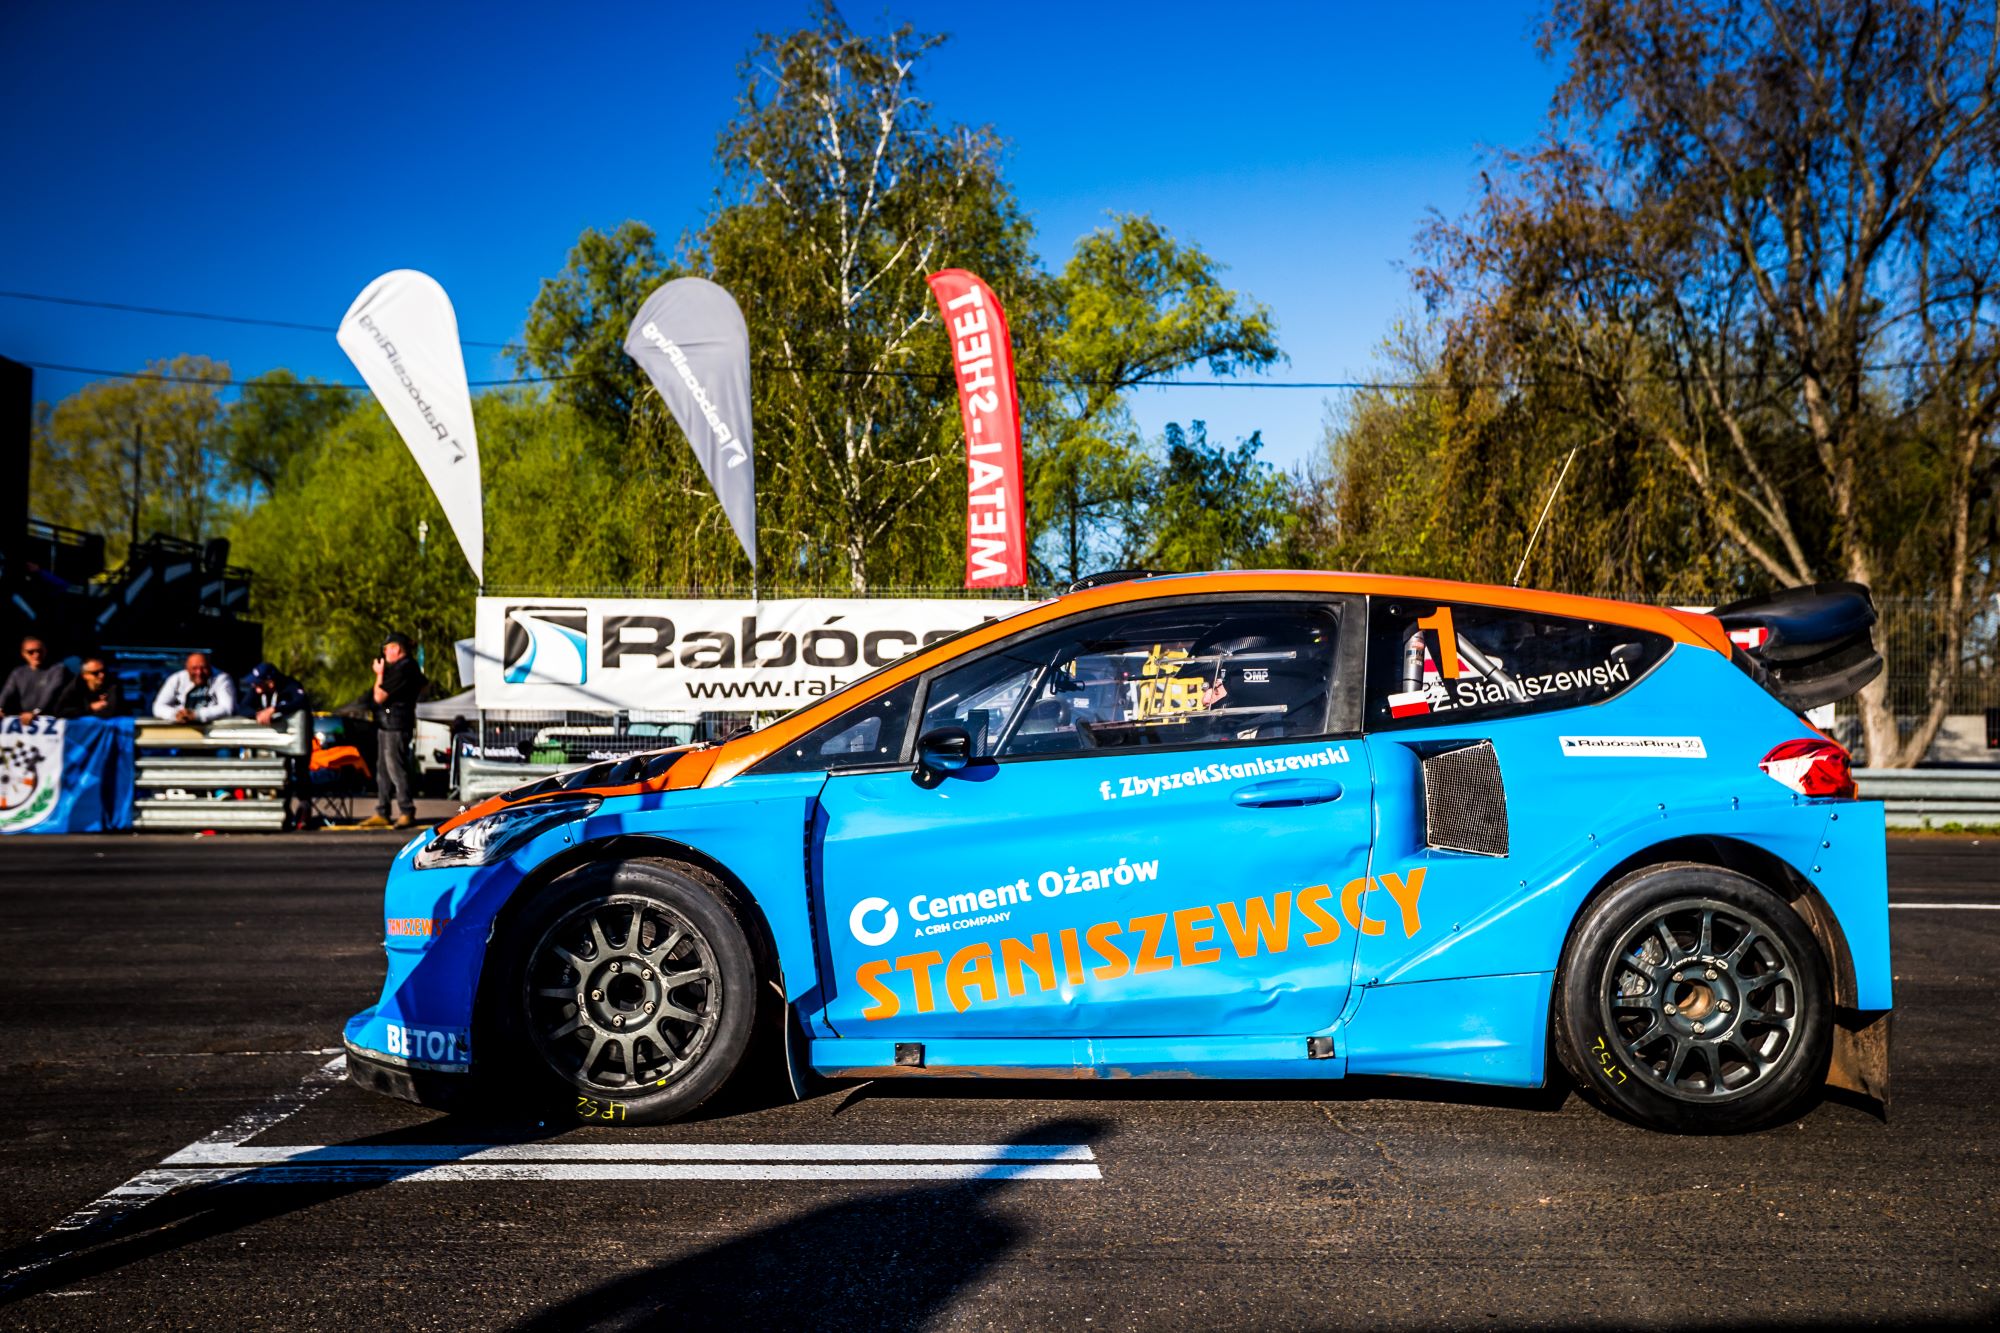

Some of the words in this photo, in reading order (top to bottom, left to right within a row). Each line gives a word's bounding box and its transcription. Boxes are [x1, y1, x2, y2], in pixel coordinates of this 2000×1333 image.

[1417, 606, 1460, 679] 1
[1243, 671, 1269, 681] OMP
[1433, 657, 1631, 712] Z.Staniszewski
[0, 717, 58, 735] ASZ
[1577, 739, 1681, 749] RabócsiRing
[1119, 746, 1350, 797] ZbyszekStaniszewski
[908, 878, 1032, 922] Cement
[1037, 857, 1159, 898] Ożarów
[855, 866, 1428, 1021] STANISZEWSCY
[914, 928, 924, 938] A
[925, 922, 950, 936] CRH
[952, 910, 1011, 931] COMPANY
